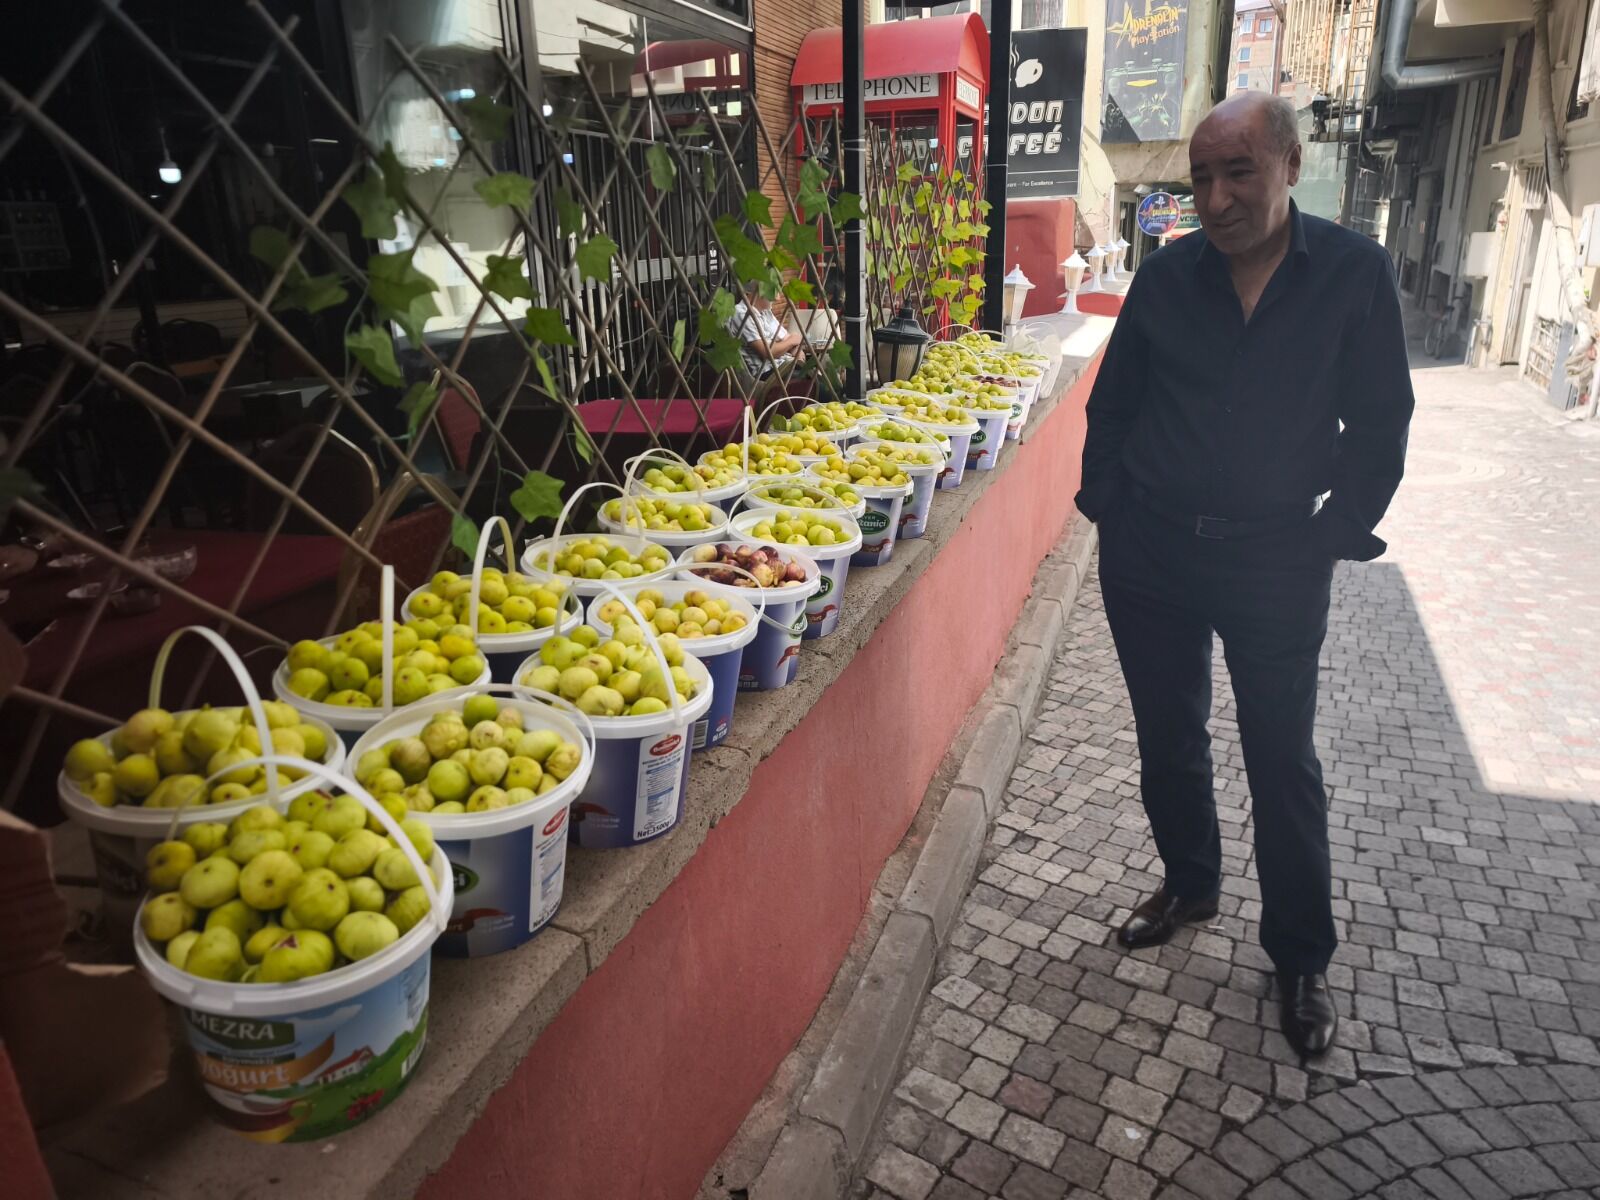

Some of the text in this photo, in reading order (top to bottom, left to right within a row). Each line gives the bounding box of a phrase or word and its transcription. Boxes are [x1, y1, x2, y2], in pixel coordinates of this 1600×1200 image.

[810, 75, 931, 100] TELPHONE
[1008, 101, 1064, 125] DON
[191, 1009, 275, 1040] MEZRA
